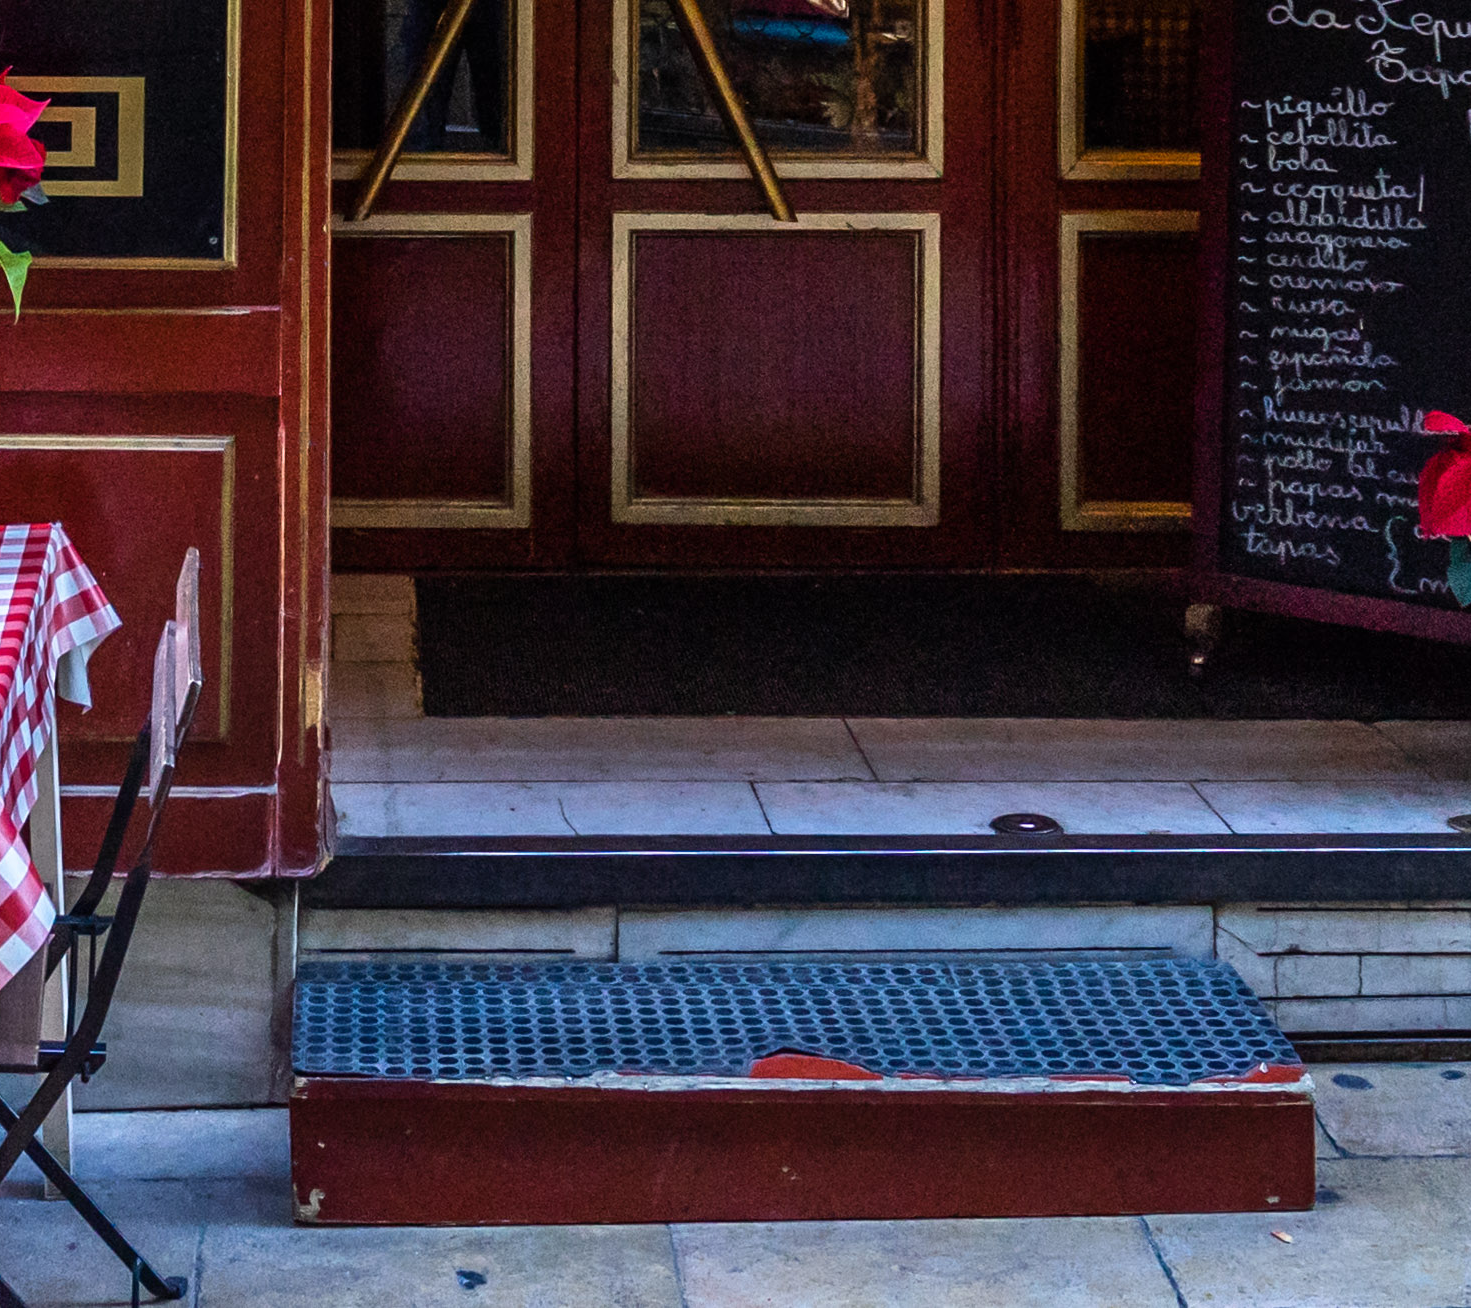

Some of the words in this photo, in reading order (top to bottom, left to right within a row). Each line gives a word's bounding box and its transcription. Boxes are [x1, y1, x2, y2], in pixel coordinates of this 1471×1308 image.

[1265, 85, 1396, 128] piquillo
[1266, 117, 1398, 149] cebollita
[1268, 144, 1338, 173] bola
[1240, 524, 1342, 566] tapas
